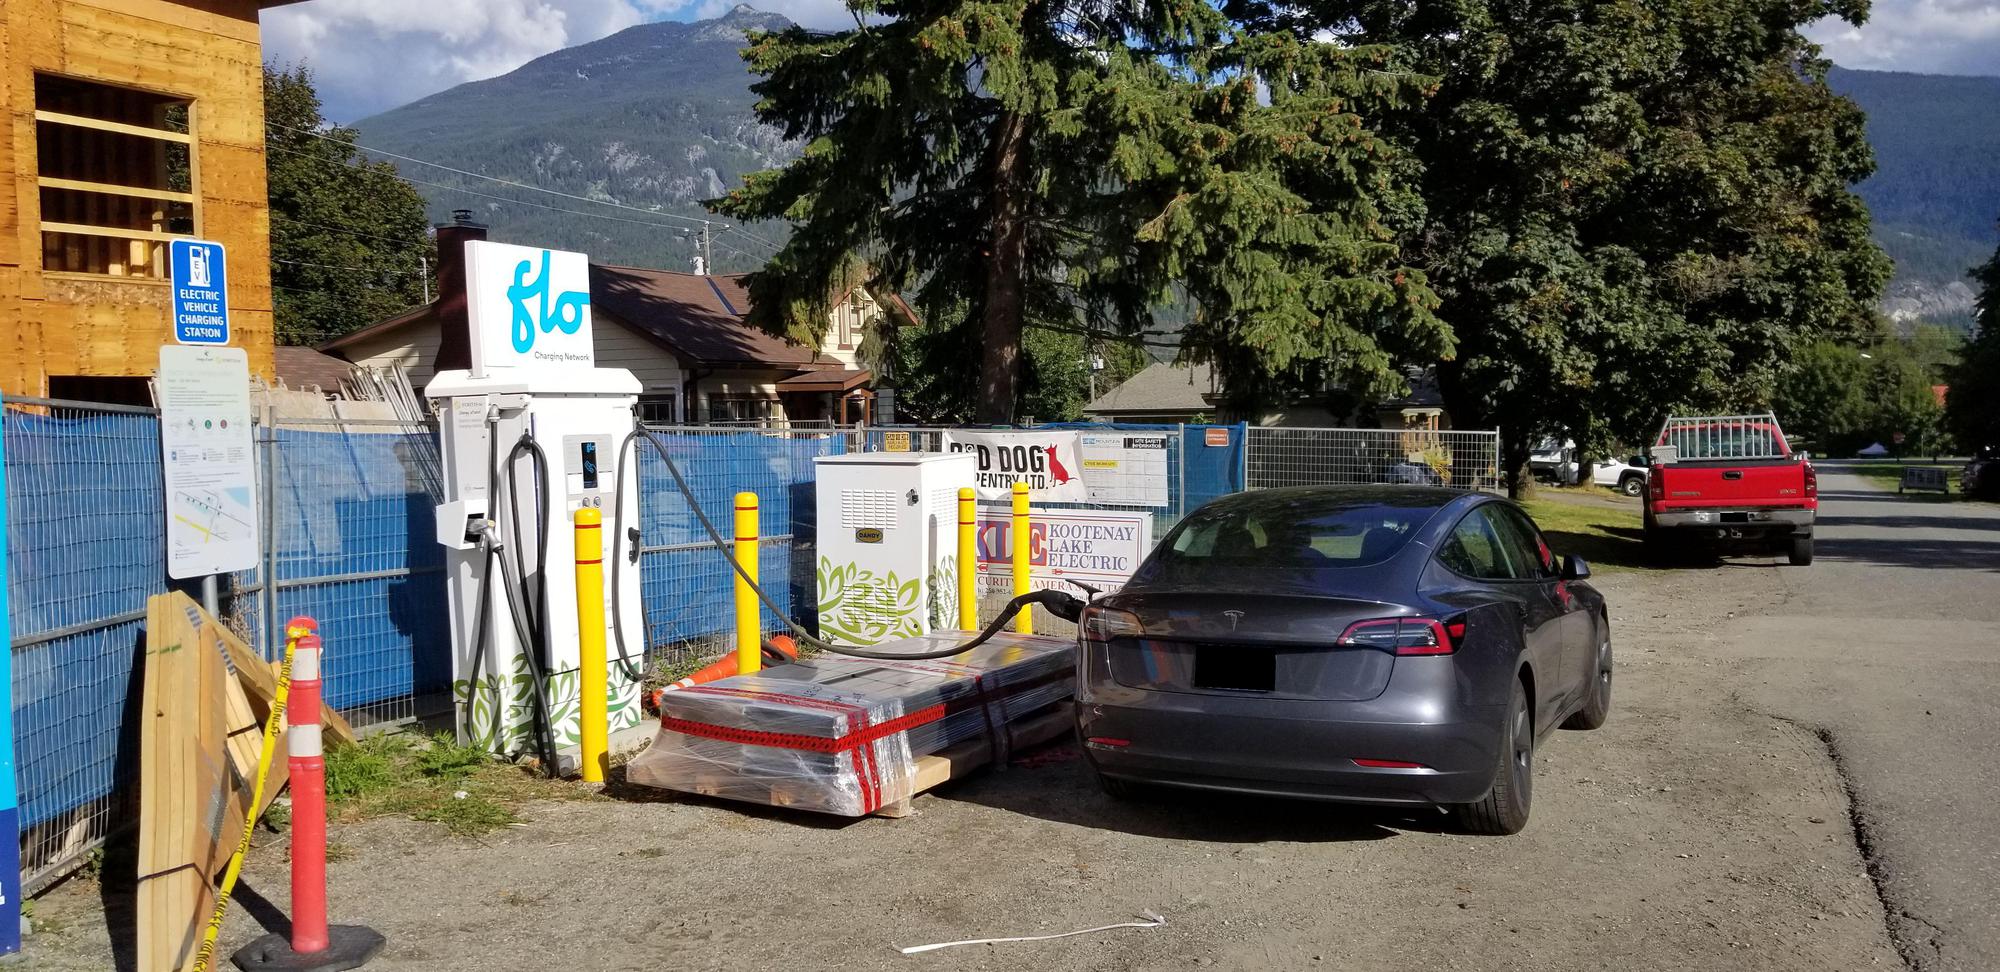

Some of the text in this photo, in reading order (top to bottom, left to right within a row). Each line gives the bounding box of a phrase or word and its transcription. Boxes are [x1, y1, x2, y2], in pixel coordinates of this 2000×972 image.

[180, 289, 220, 301] ELECTRIC
[183, 301, 219, 313] VEHICLE
[507, 249, 590, 354] flo
[179, 314, 224, 326] CHARGING
[184, 327, 221, 338] STATION
[534, 351, 590, 362] Charging Network
[998, 445, 1045, 473] DOG
[1050, 524, 1136, 541] KOOTENAY
[1049, 538, 1093, 554] LAKE
[1048, 553, 1128, 571] ELECTRIC
[1030, 579, 1073, 590] AMERA
